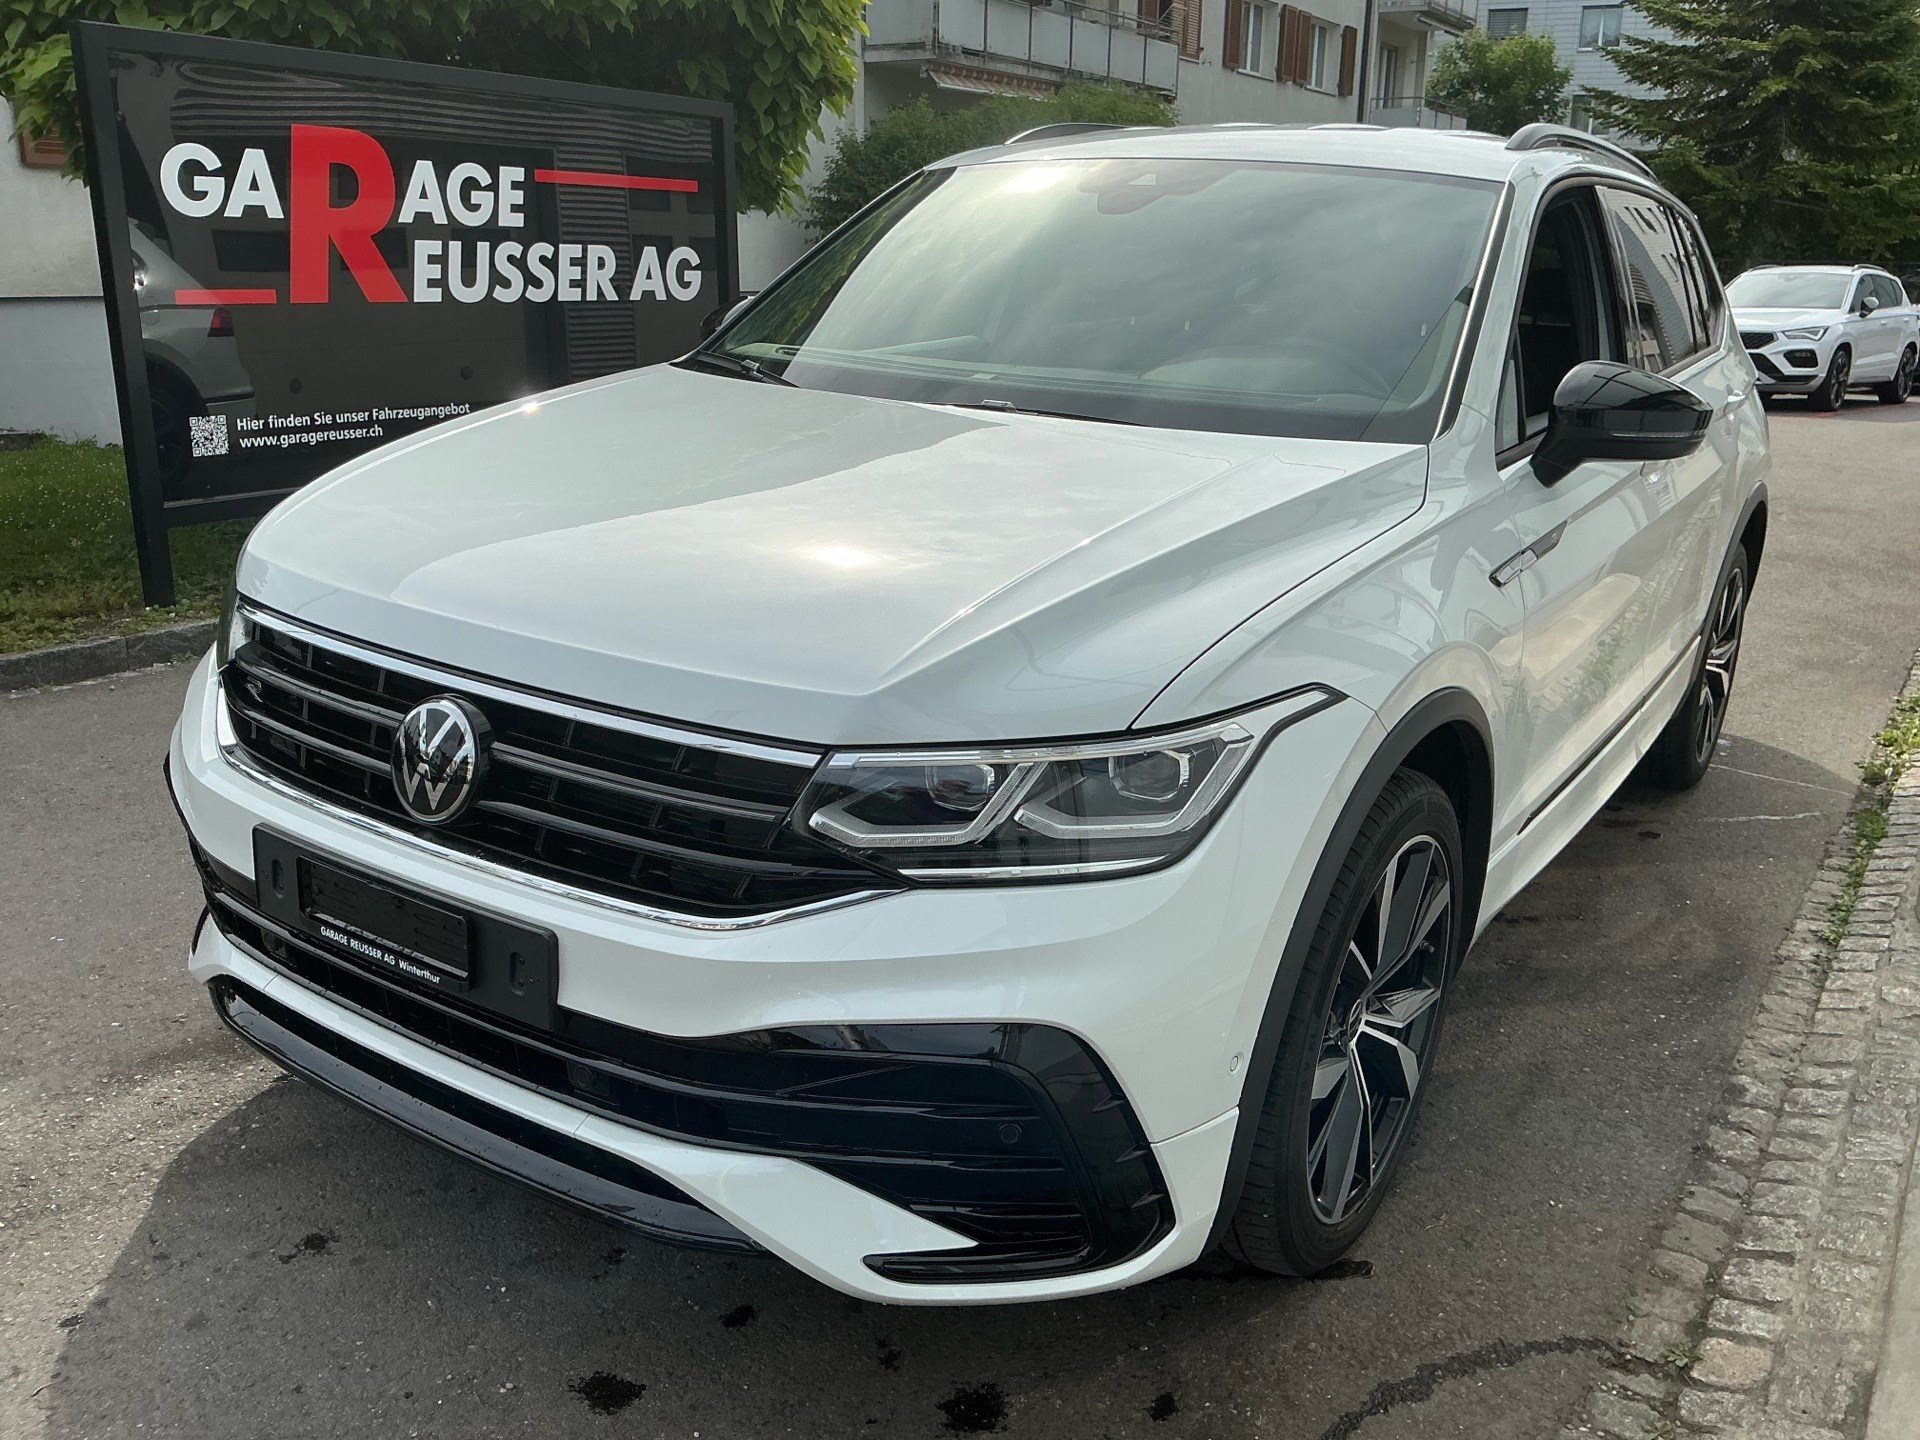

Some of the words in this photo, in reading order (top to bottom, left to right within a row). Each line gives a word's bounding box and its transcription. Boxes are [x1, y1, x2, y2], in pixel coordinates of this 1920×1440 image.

[160, 123, 525, 303] GARAGE
[629, 246, 702, 301] AG
[237, 416, 264, 431] Hier
[268, 414, 311, 428] finden
[314, 411, 333, 425] Sie
[336, 409, 370, 423] unser
[372, 403, 471, 421] Fahrzeugangebot
[239, 424, 383, 448] www.garagereusser.ch
[320, 926, 348, 945] GARAGE
[350, 938, 382, 960] REUSSER
[384, 953, 395, 965] AG
[399, 959, 440, 983] Winterthur
